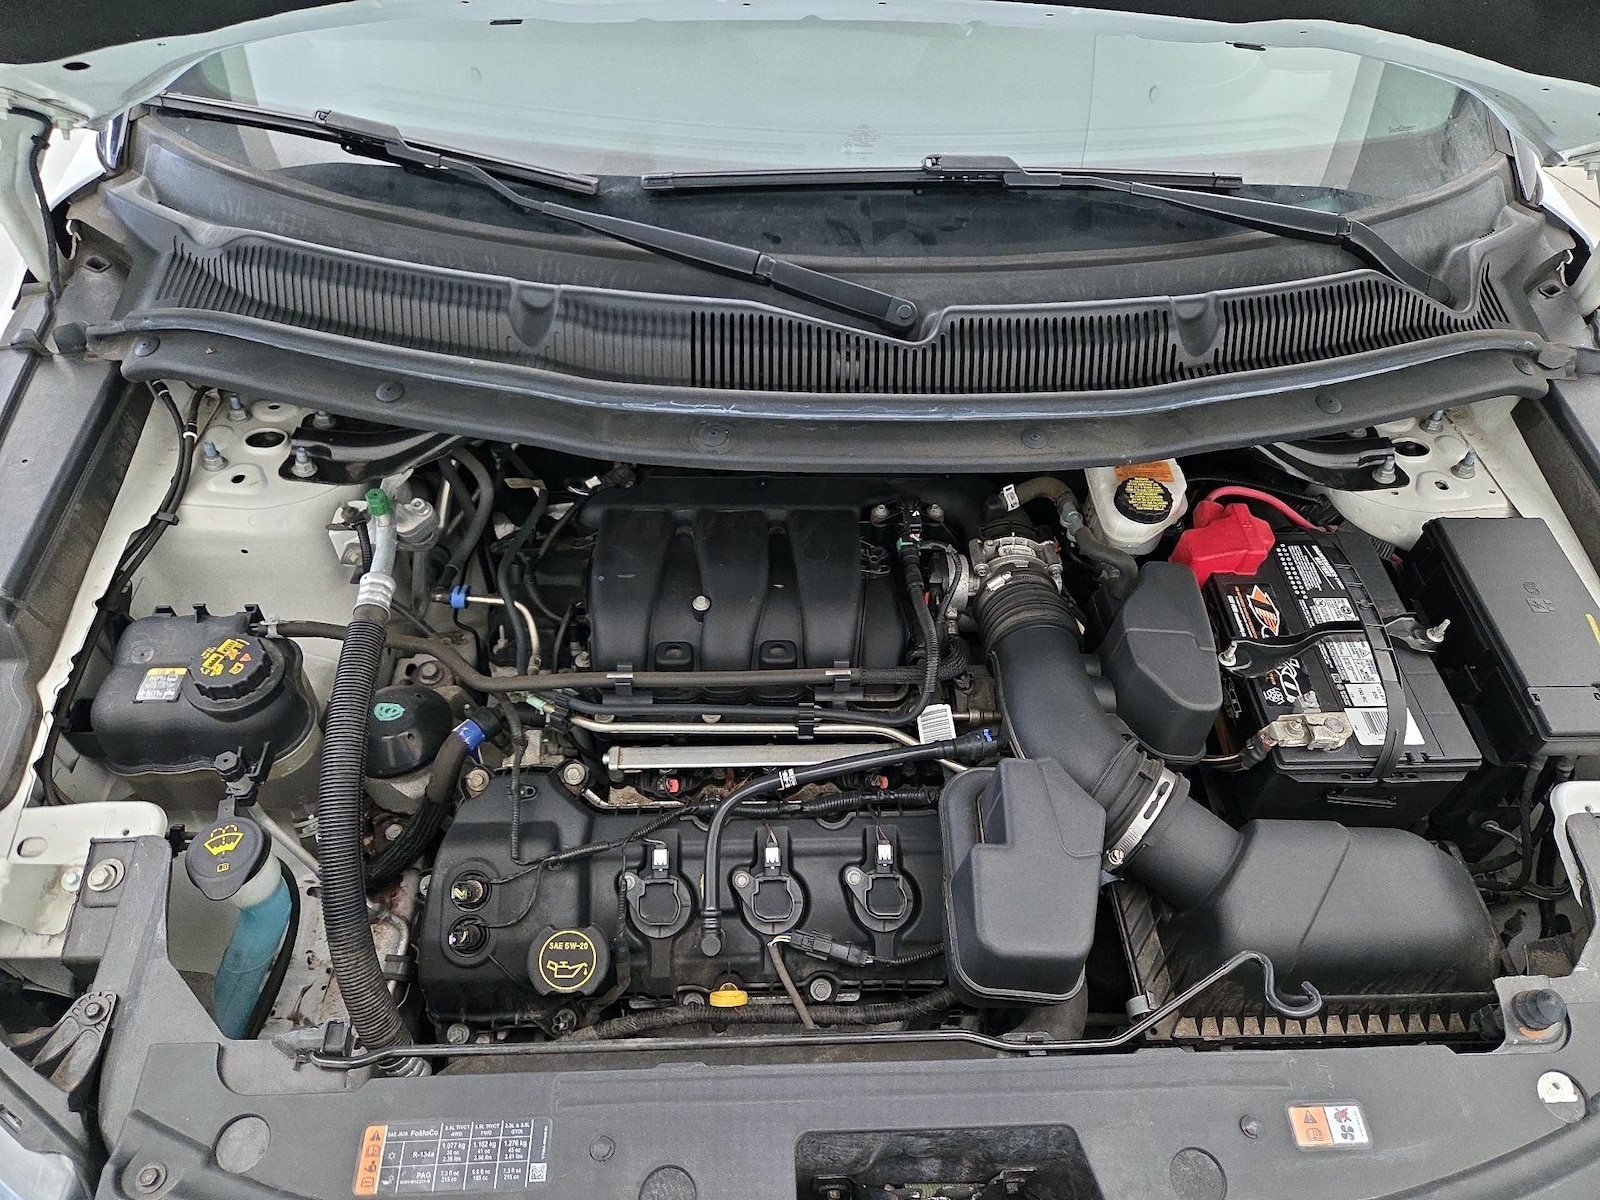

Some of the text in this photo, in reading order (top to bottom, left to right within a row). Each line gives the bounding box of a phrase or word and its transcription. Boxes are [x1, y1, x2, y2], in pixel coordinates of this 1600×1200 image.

[549, 942, 589, 950] SAE 5W-20
[458, 1142, 466, 1150] kg
[520, 1140, 527, 1148] kg
